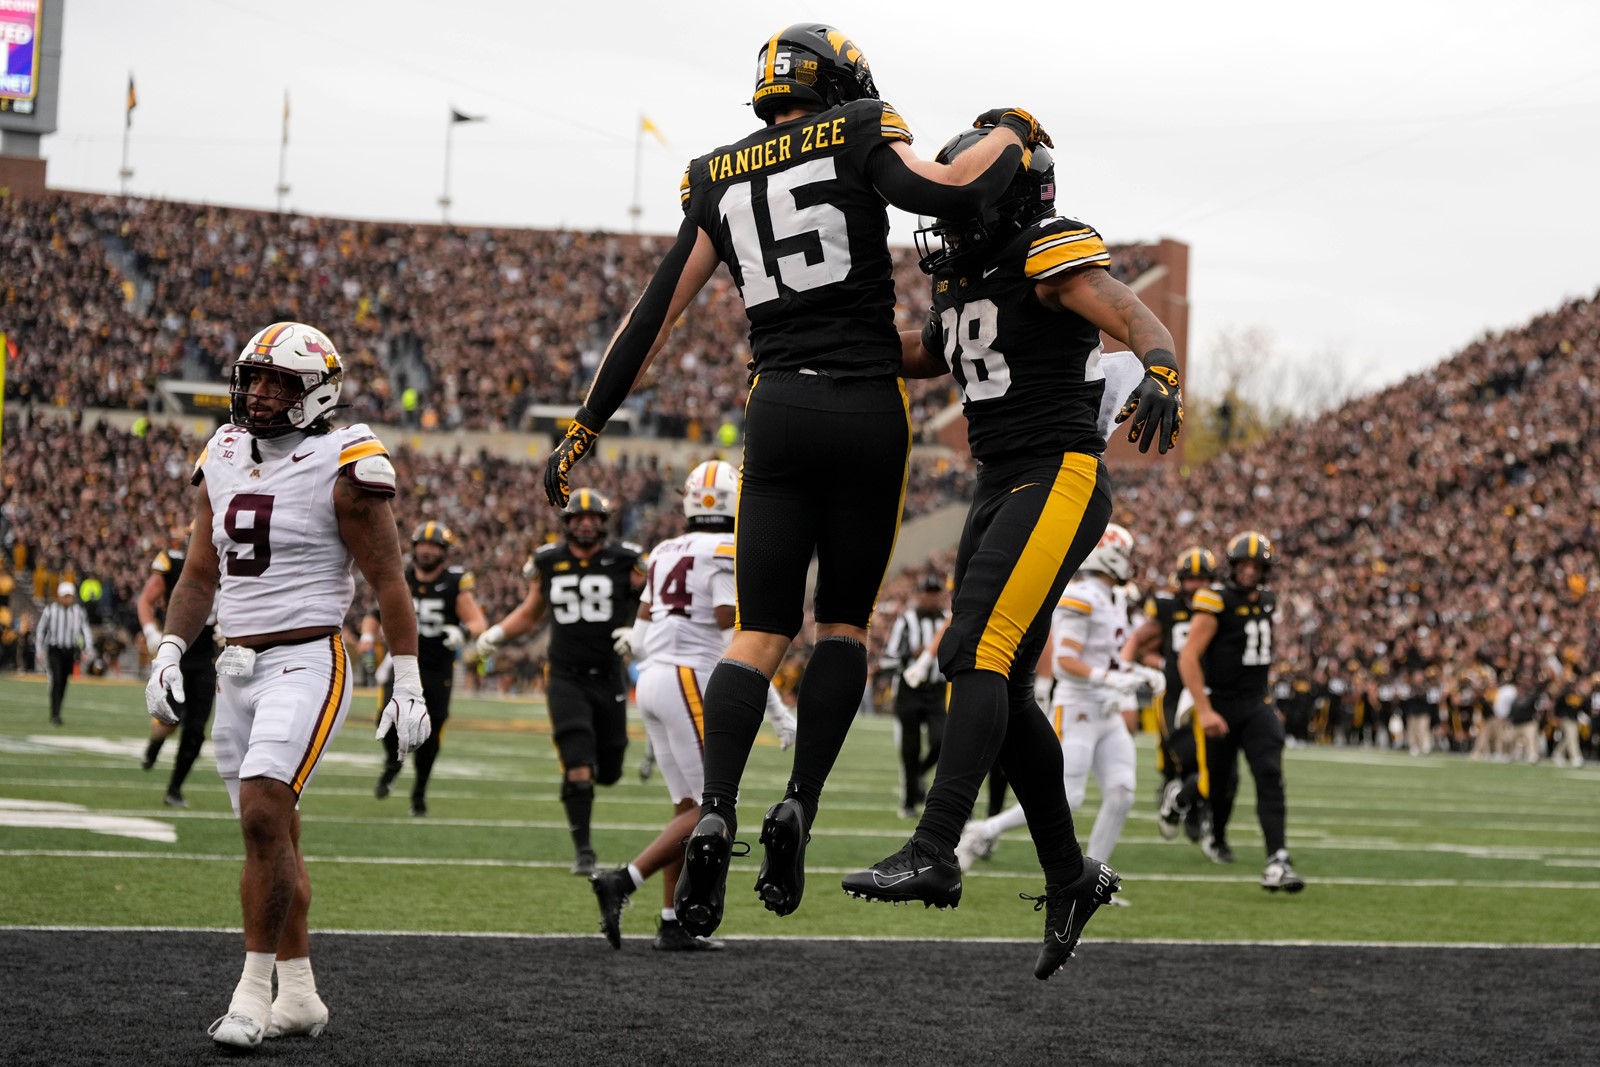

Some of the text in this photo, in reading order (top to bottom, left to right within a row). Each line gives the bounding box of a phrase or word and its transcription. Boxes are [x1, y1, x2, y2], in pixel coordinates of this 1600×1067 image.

[708, 117, 846, 182] VANDER ZEE
[718, 156, 852, 309] 15
[224, 494, 275, 577] 9
[412, 598, 444, 638] 5
[550, 574, 613, 624] 58
[649, 556, 695, 618] 14
[1242, 618, 1272, 666] 11
